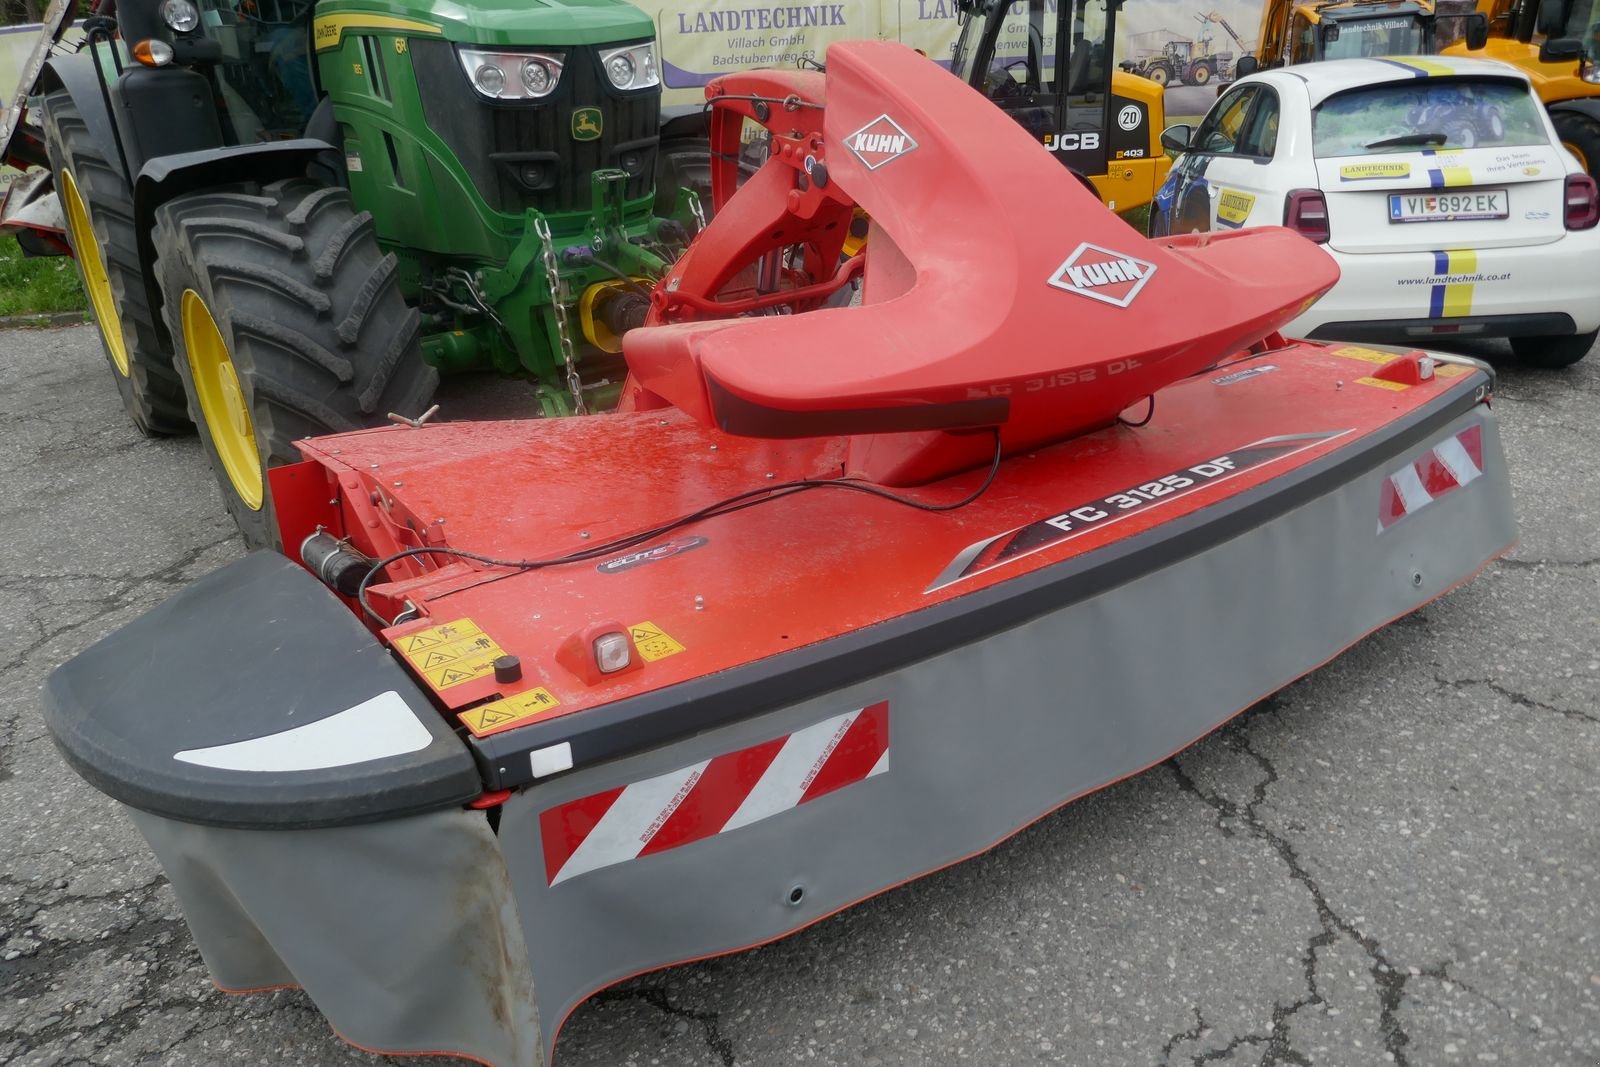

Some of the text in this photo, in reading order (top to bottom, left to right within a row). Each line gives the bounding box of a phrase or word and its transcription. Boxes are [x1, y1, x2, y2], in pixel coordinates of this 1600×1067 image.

[678, 5, 846, 34] LANDTECHNIK
[727, 35, 805, 48] Villach GmbH
[712, 52, 798, 66] Badstubenweg
[1122, 111, 1137, 124] 20
[854, 133, 906, 154] KUHN
[1044, 132, 1100, 151] JCB
[1123, 149, 1144, 158] 403
[1344, 164, 1404, 173] LANDTECHNIK
[1407, 194, 1498, 214] VI 692 EK
[1065, 259, 1145, 288] KUHN
[1397, 273, 1511, 286] www.landtechnik.co.at
[1044, 456, 1236, 531] FC 3125 DF
[607, 546, 668, 569] ELITE
